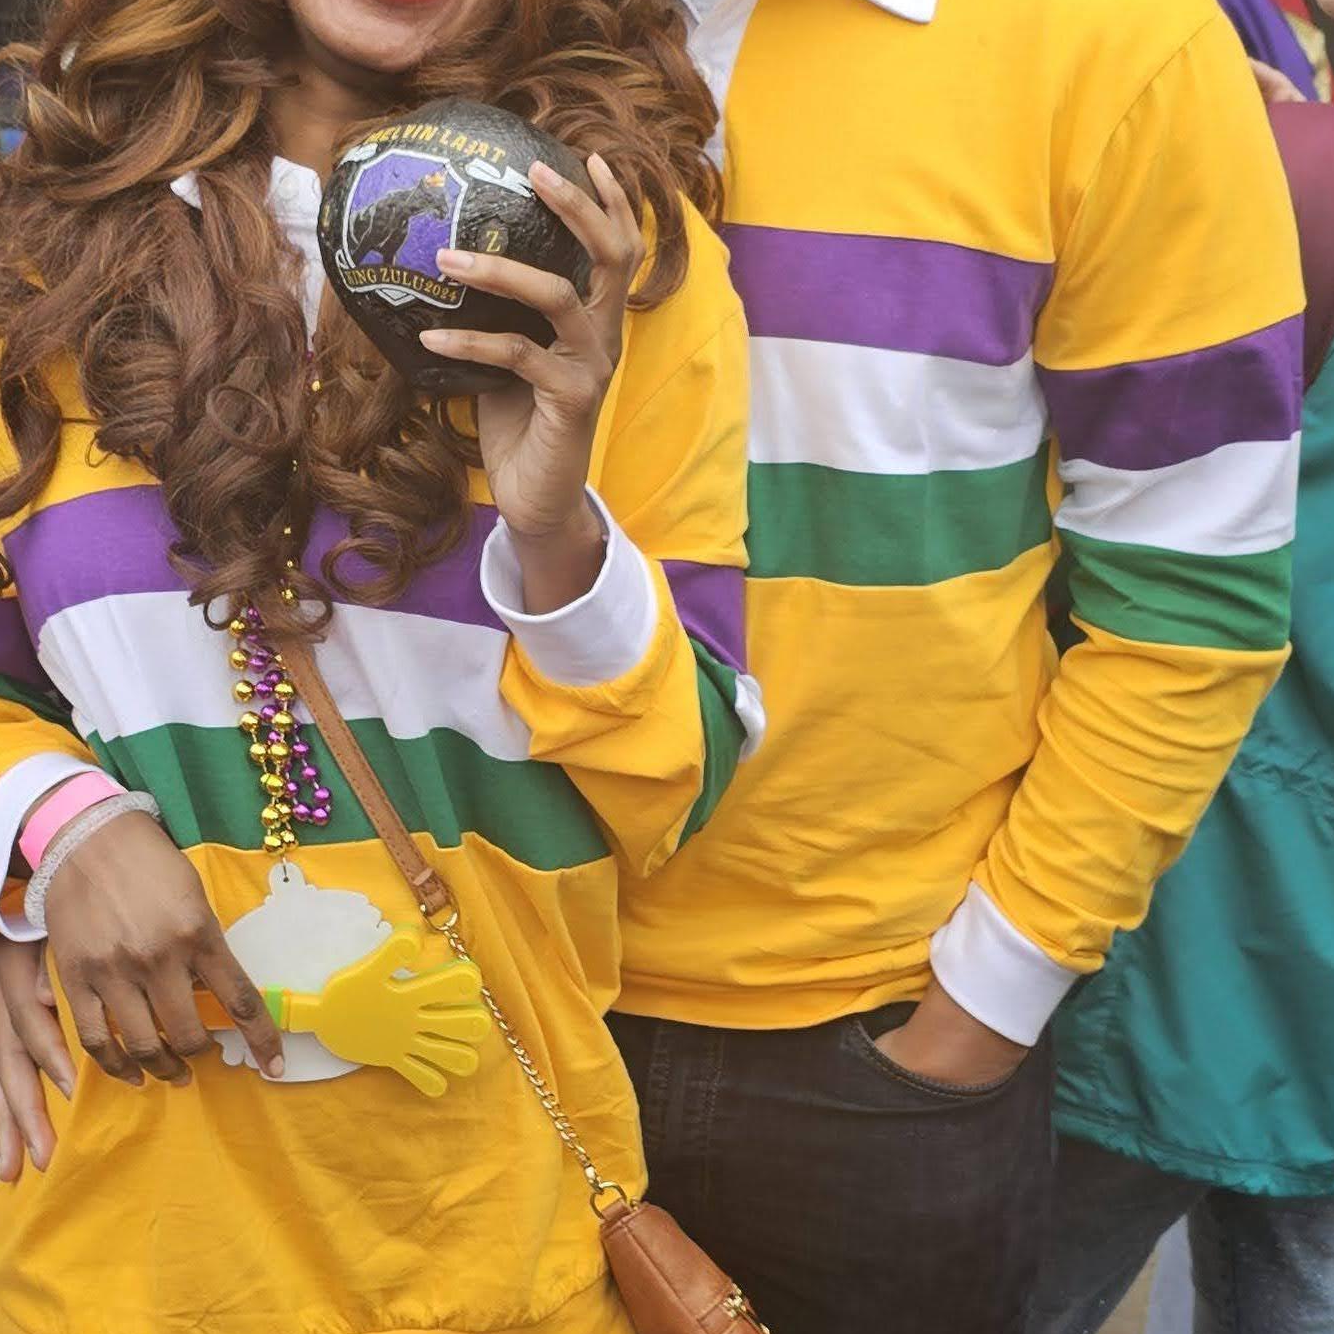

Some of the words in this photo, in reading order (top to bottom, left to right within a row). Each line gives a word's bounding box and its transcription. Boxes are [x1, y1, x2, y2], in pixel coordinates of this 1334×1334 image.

[486, 229, 501, 252] Z
[380, 267, 424, 290] ZULU
[424, 281, 458, 302] 2024
